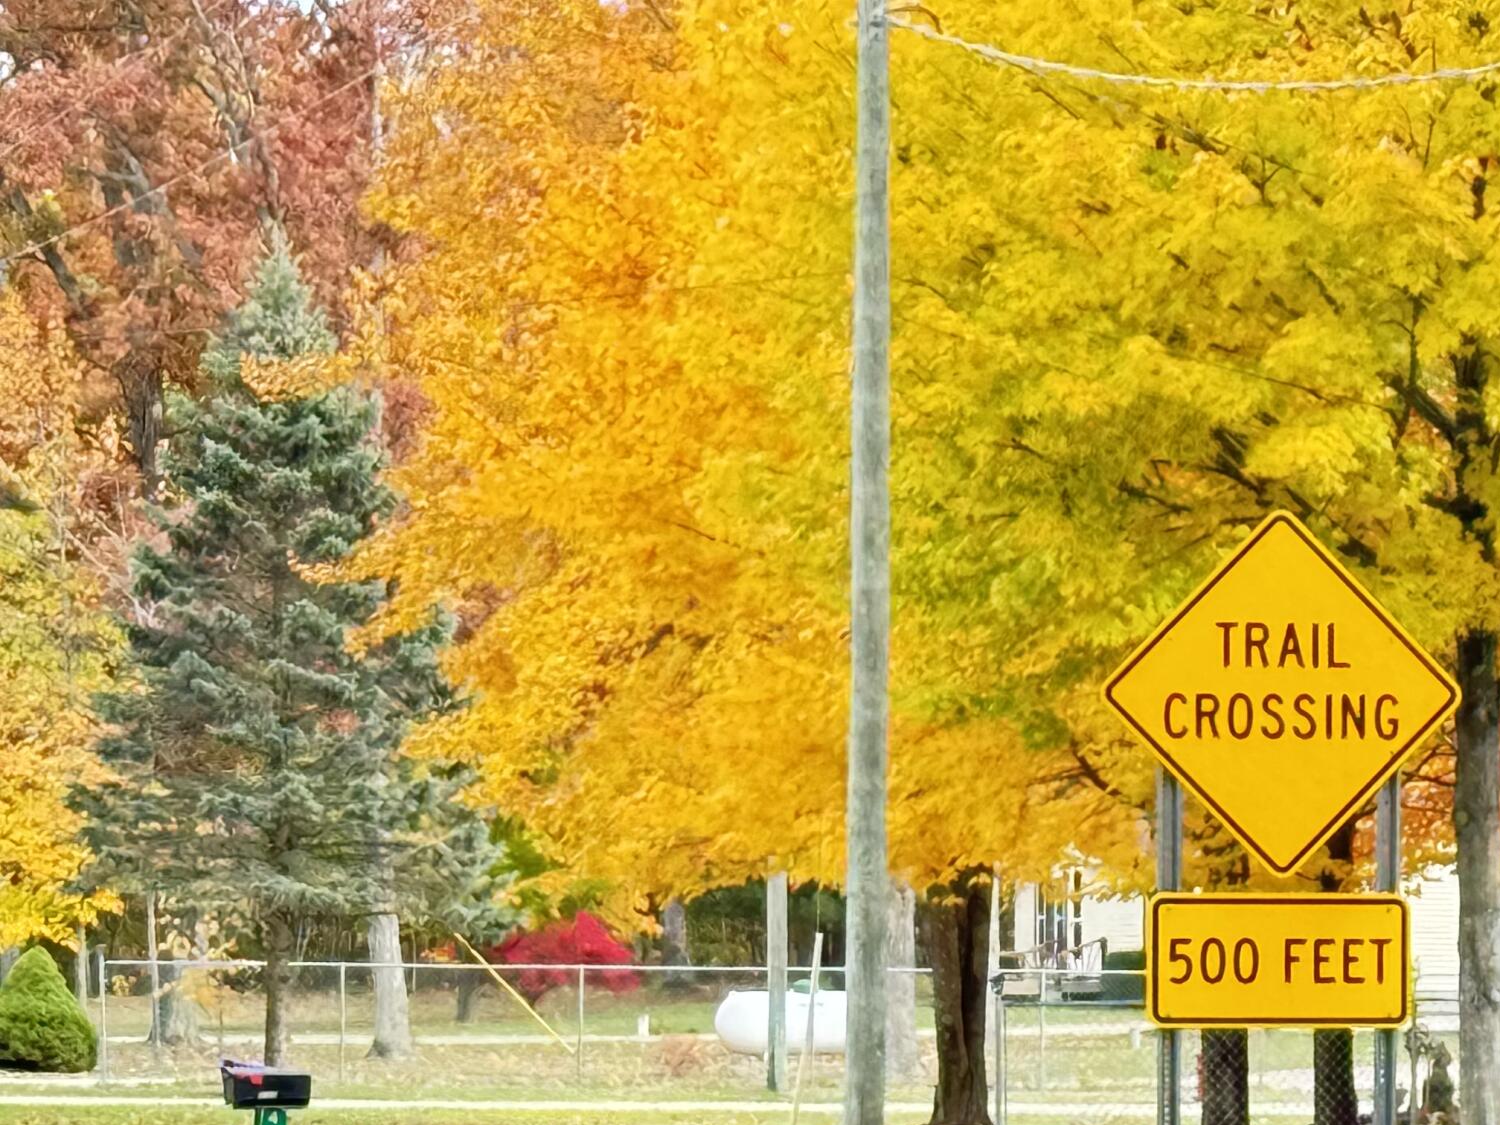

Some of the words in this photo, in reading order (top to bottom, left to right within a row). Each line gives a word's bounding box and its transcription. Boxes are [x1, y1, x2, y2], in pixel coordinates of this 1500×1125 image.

[1215, 622, 1351, 669] TRAIL
[1163, 692, 1400, 741] CROSSING
[1168, 937, 1260, 985] 500
[1284, 937, 1393, 985] FEET
